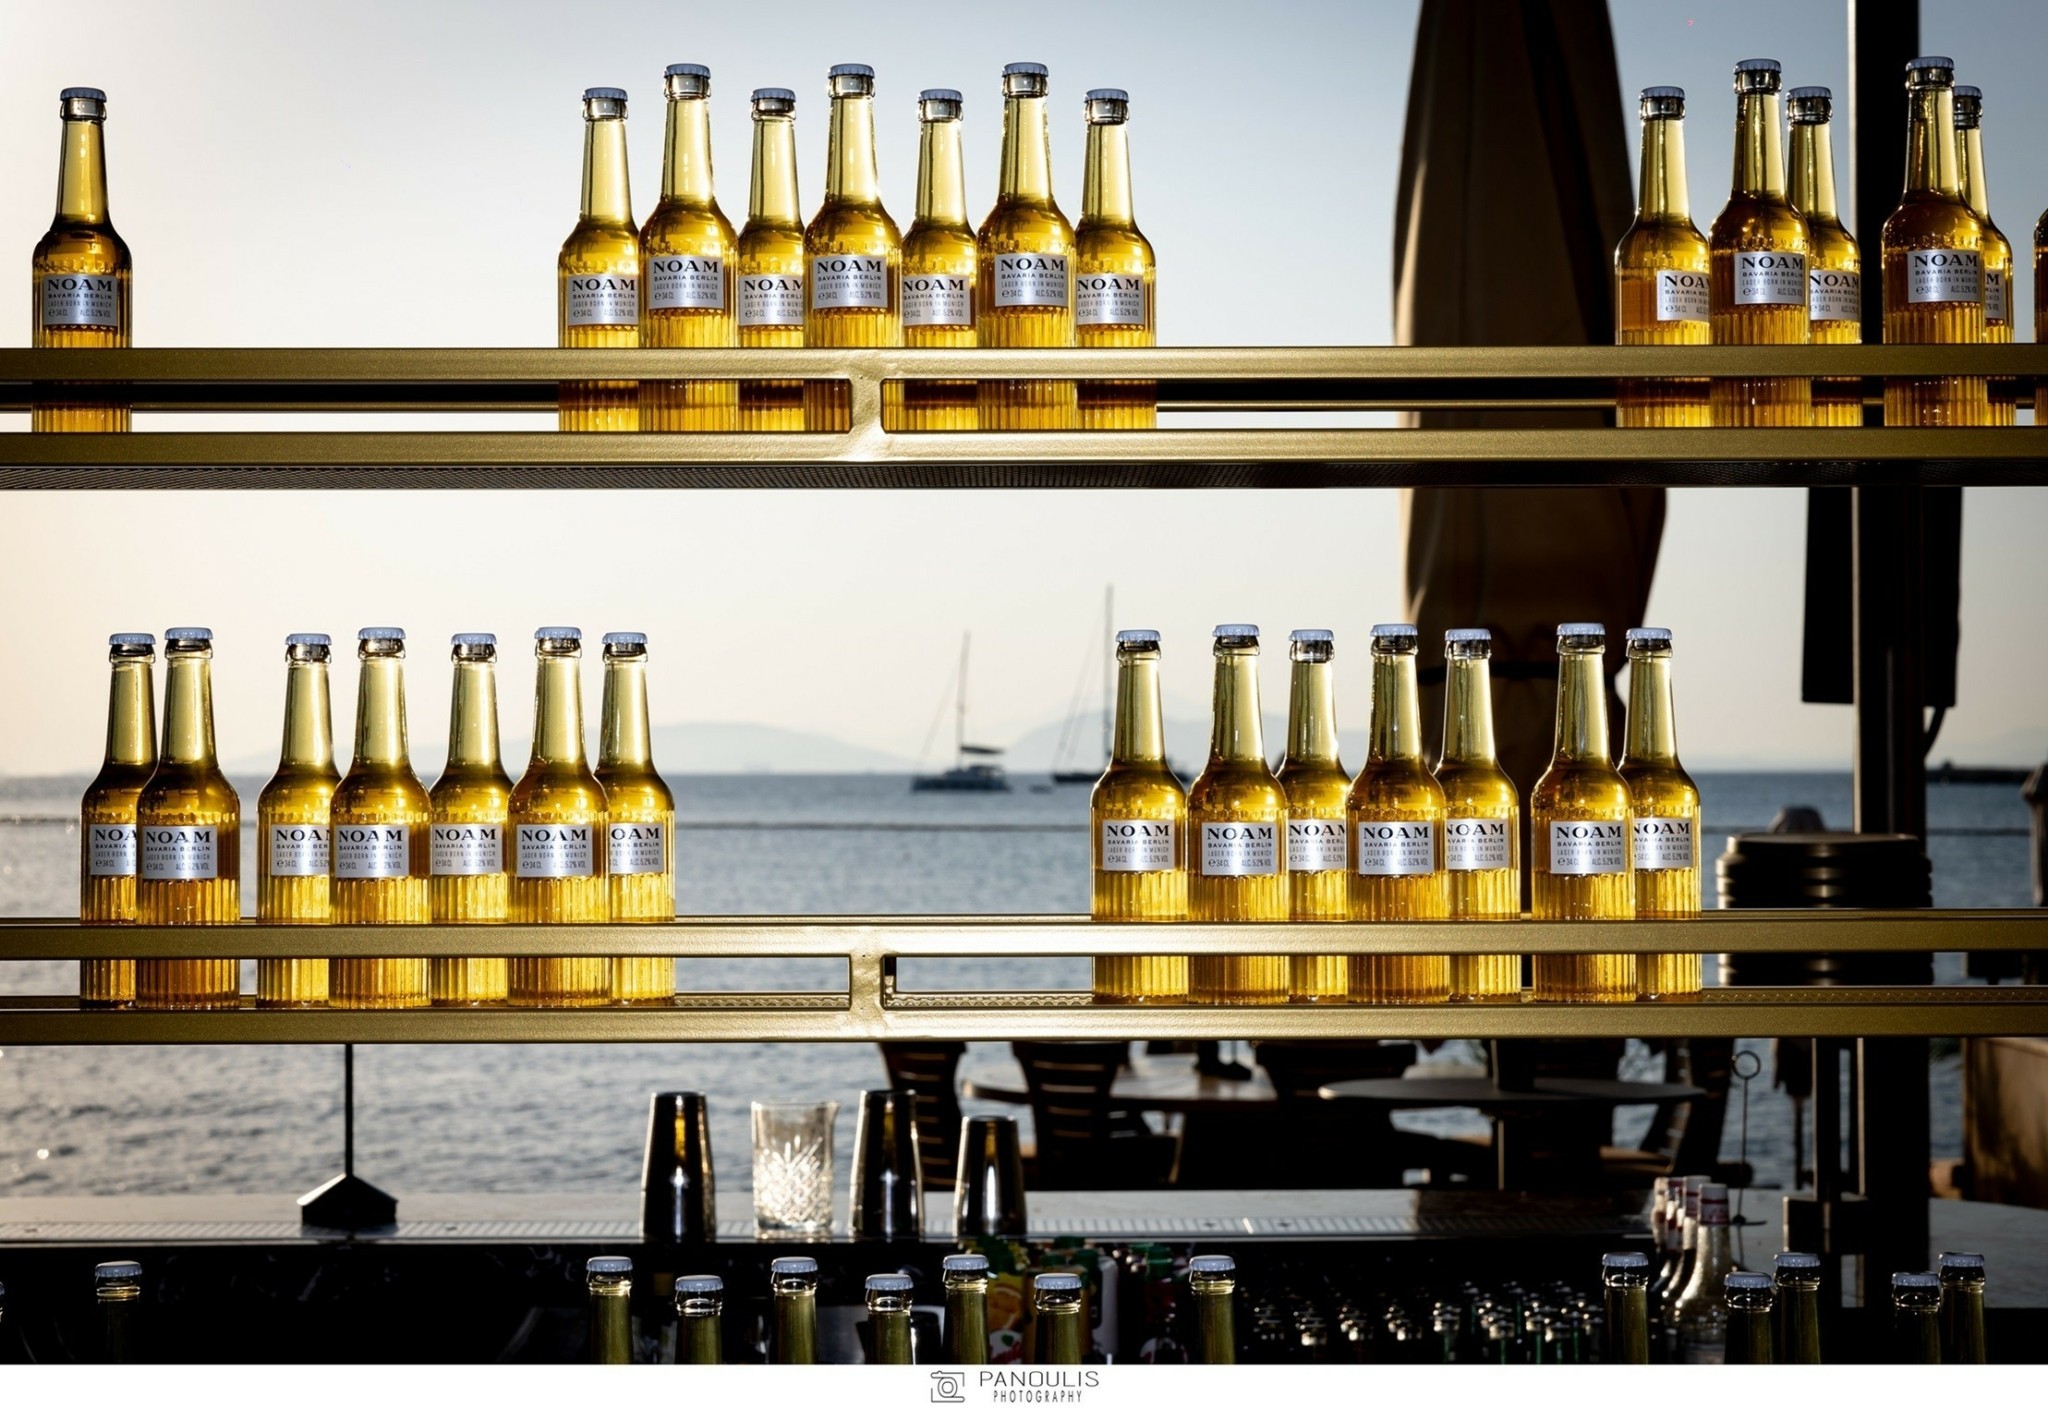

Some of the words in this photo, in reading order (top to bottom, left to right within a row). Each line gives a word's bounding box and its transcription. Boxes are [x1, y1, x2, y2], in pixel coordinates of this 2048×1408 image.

[653, 260, 718, 273] NOAM
[817, 259, 882, 273] NOAM
[1001, 258, 1065, 271] NOAM
[1741, 256, 1803, 270] NOAM
[1914, 254, 1977, 267] NOAM
[47, 278, 112, 292] NOAM
[572, 278, 635, 291] NOAM
[744, 279, 803, 292] NOAM
[903, 279, 964, 292] NOAM
[1077, 278, 1140, 291] NOAM
[1664, 275, 1709, 289] NOA
[95, 829, 137, 842] NOA
[146, 831, 211, 843] NOAM
[276, 829, 330, 841] NOA
[338, 829, 402, 842] NOAM
[435, 829, 496, 840] NOAM
[521, 829, 587, 842] NOAM
[611, 828, 659, 840] OAM
[1107, 825, 1170, 837] NOAM
[1207, 827, 1272, 840] NOAM
[1363, 826, 1429, 839] NOAM
[1556, 825, 1621, 839] NOAM
